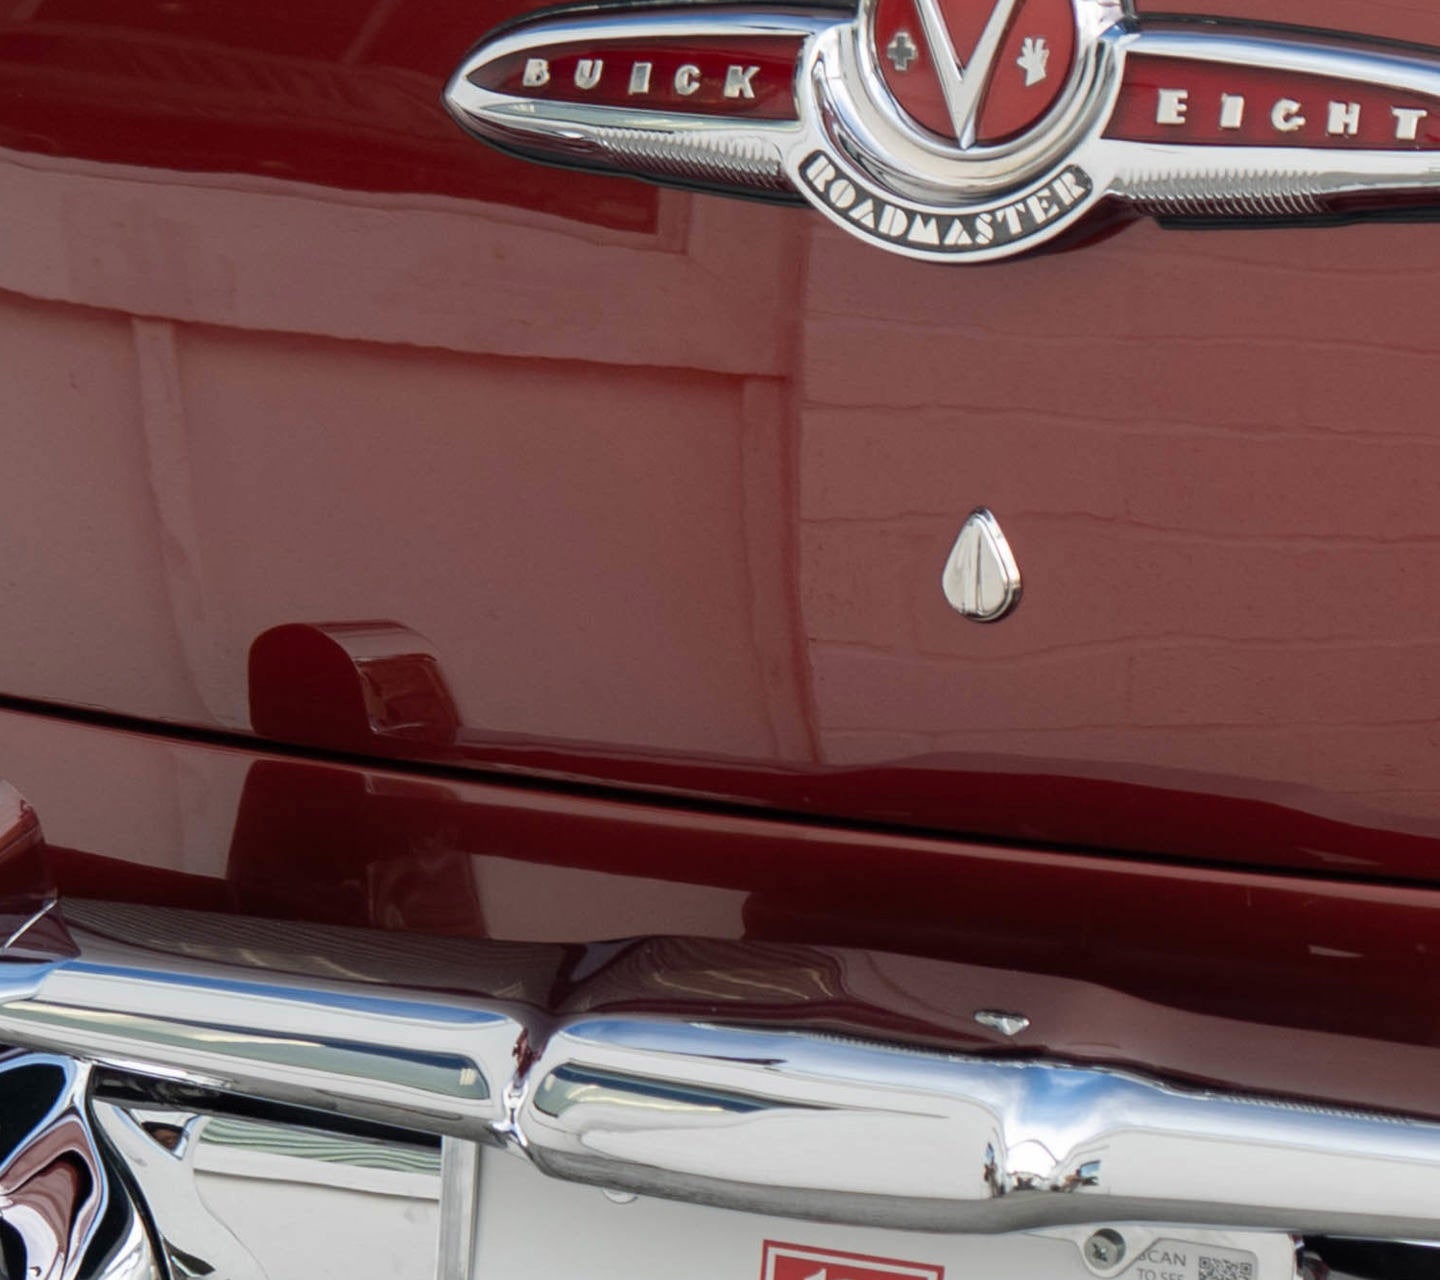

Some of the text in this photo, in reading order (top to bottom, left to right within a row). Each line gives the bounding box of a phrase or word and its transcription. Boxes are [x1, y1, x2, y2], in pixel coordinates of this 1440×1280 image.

[522, 57, 1428, 140] BUICK EIGHT
[806, 153, 1087, 246] ROADMASTER
